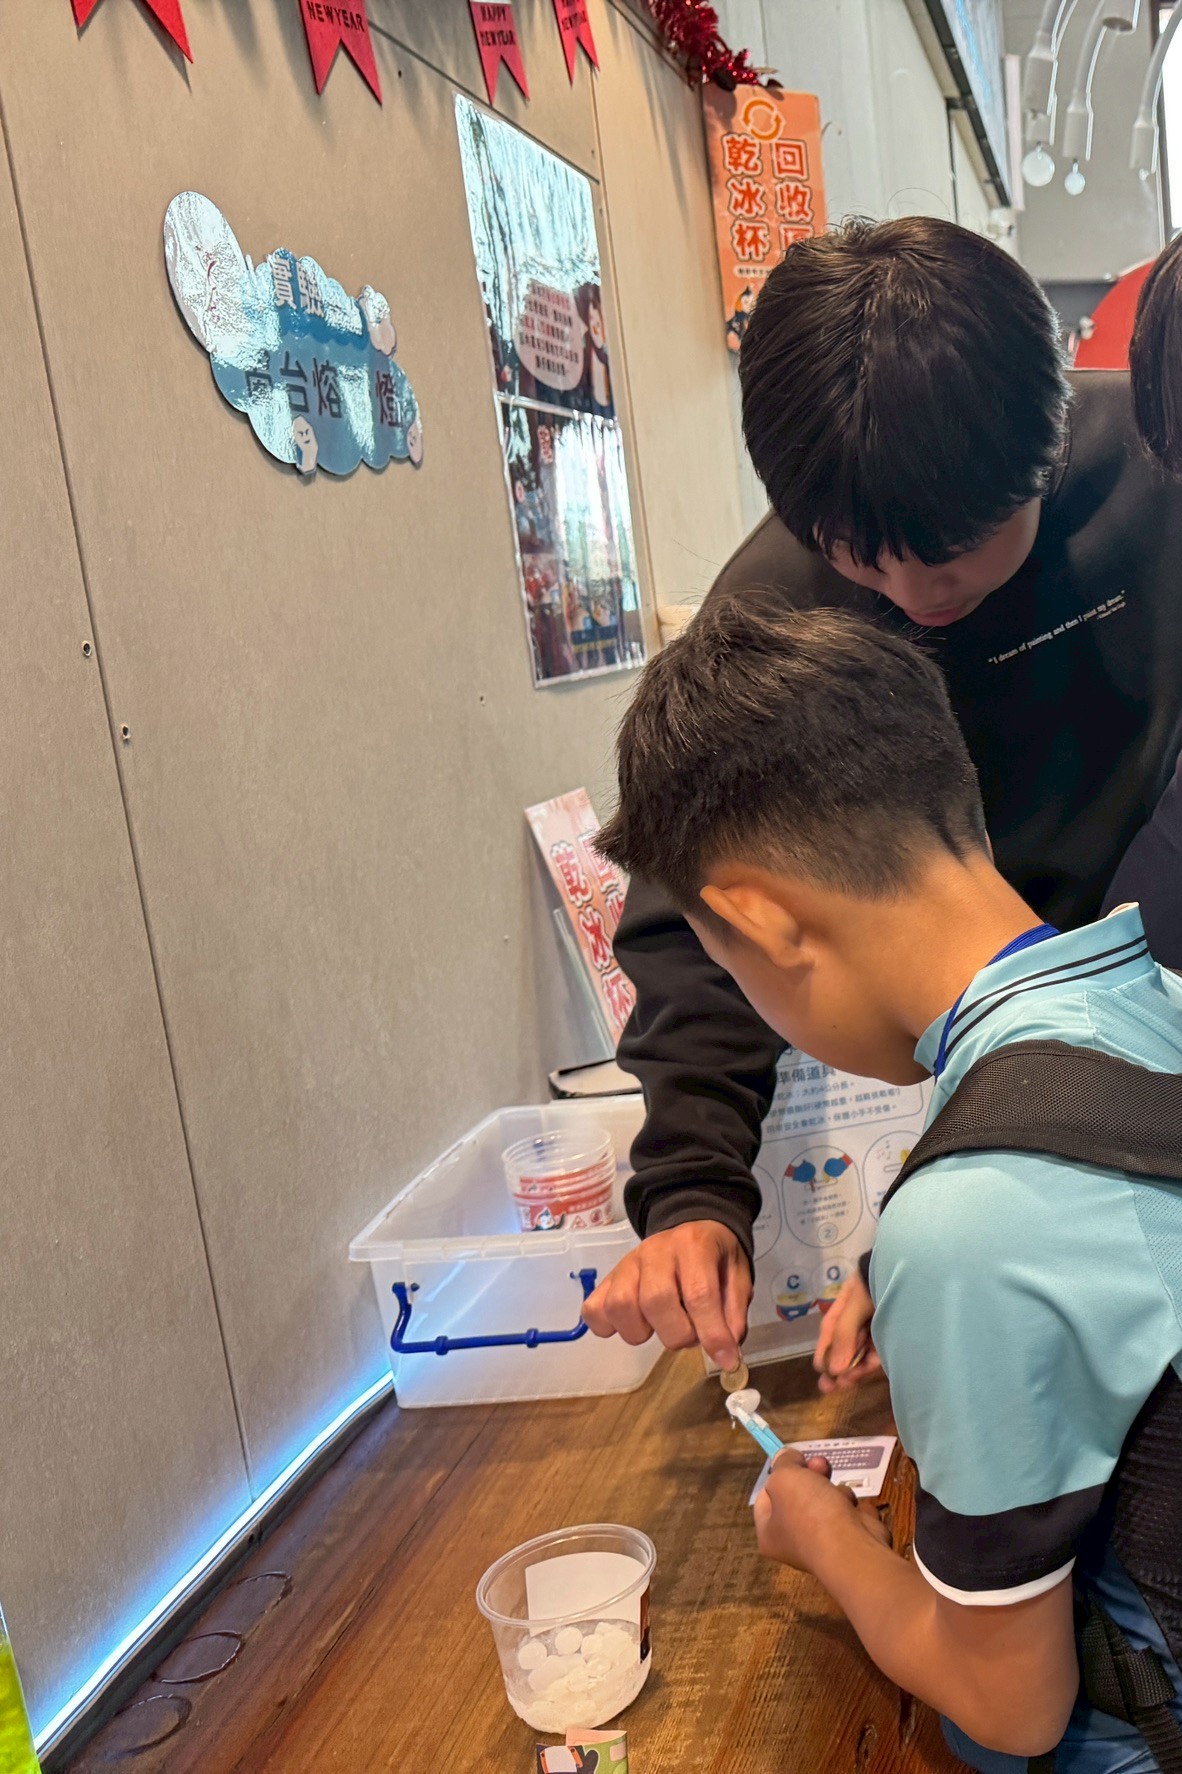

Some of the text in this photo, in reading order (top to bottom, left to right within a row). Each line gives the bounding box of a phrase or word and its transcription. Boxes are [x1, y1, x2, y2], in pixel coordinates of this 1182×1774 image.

[725, 136, 770, 259] 乾冰杯
[786, 1274, 801, 1290] C
